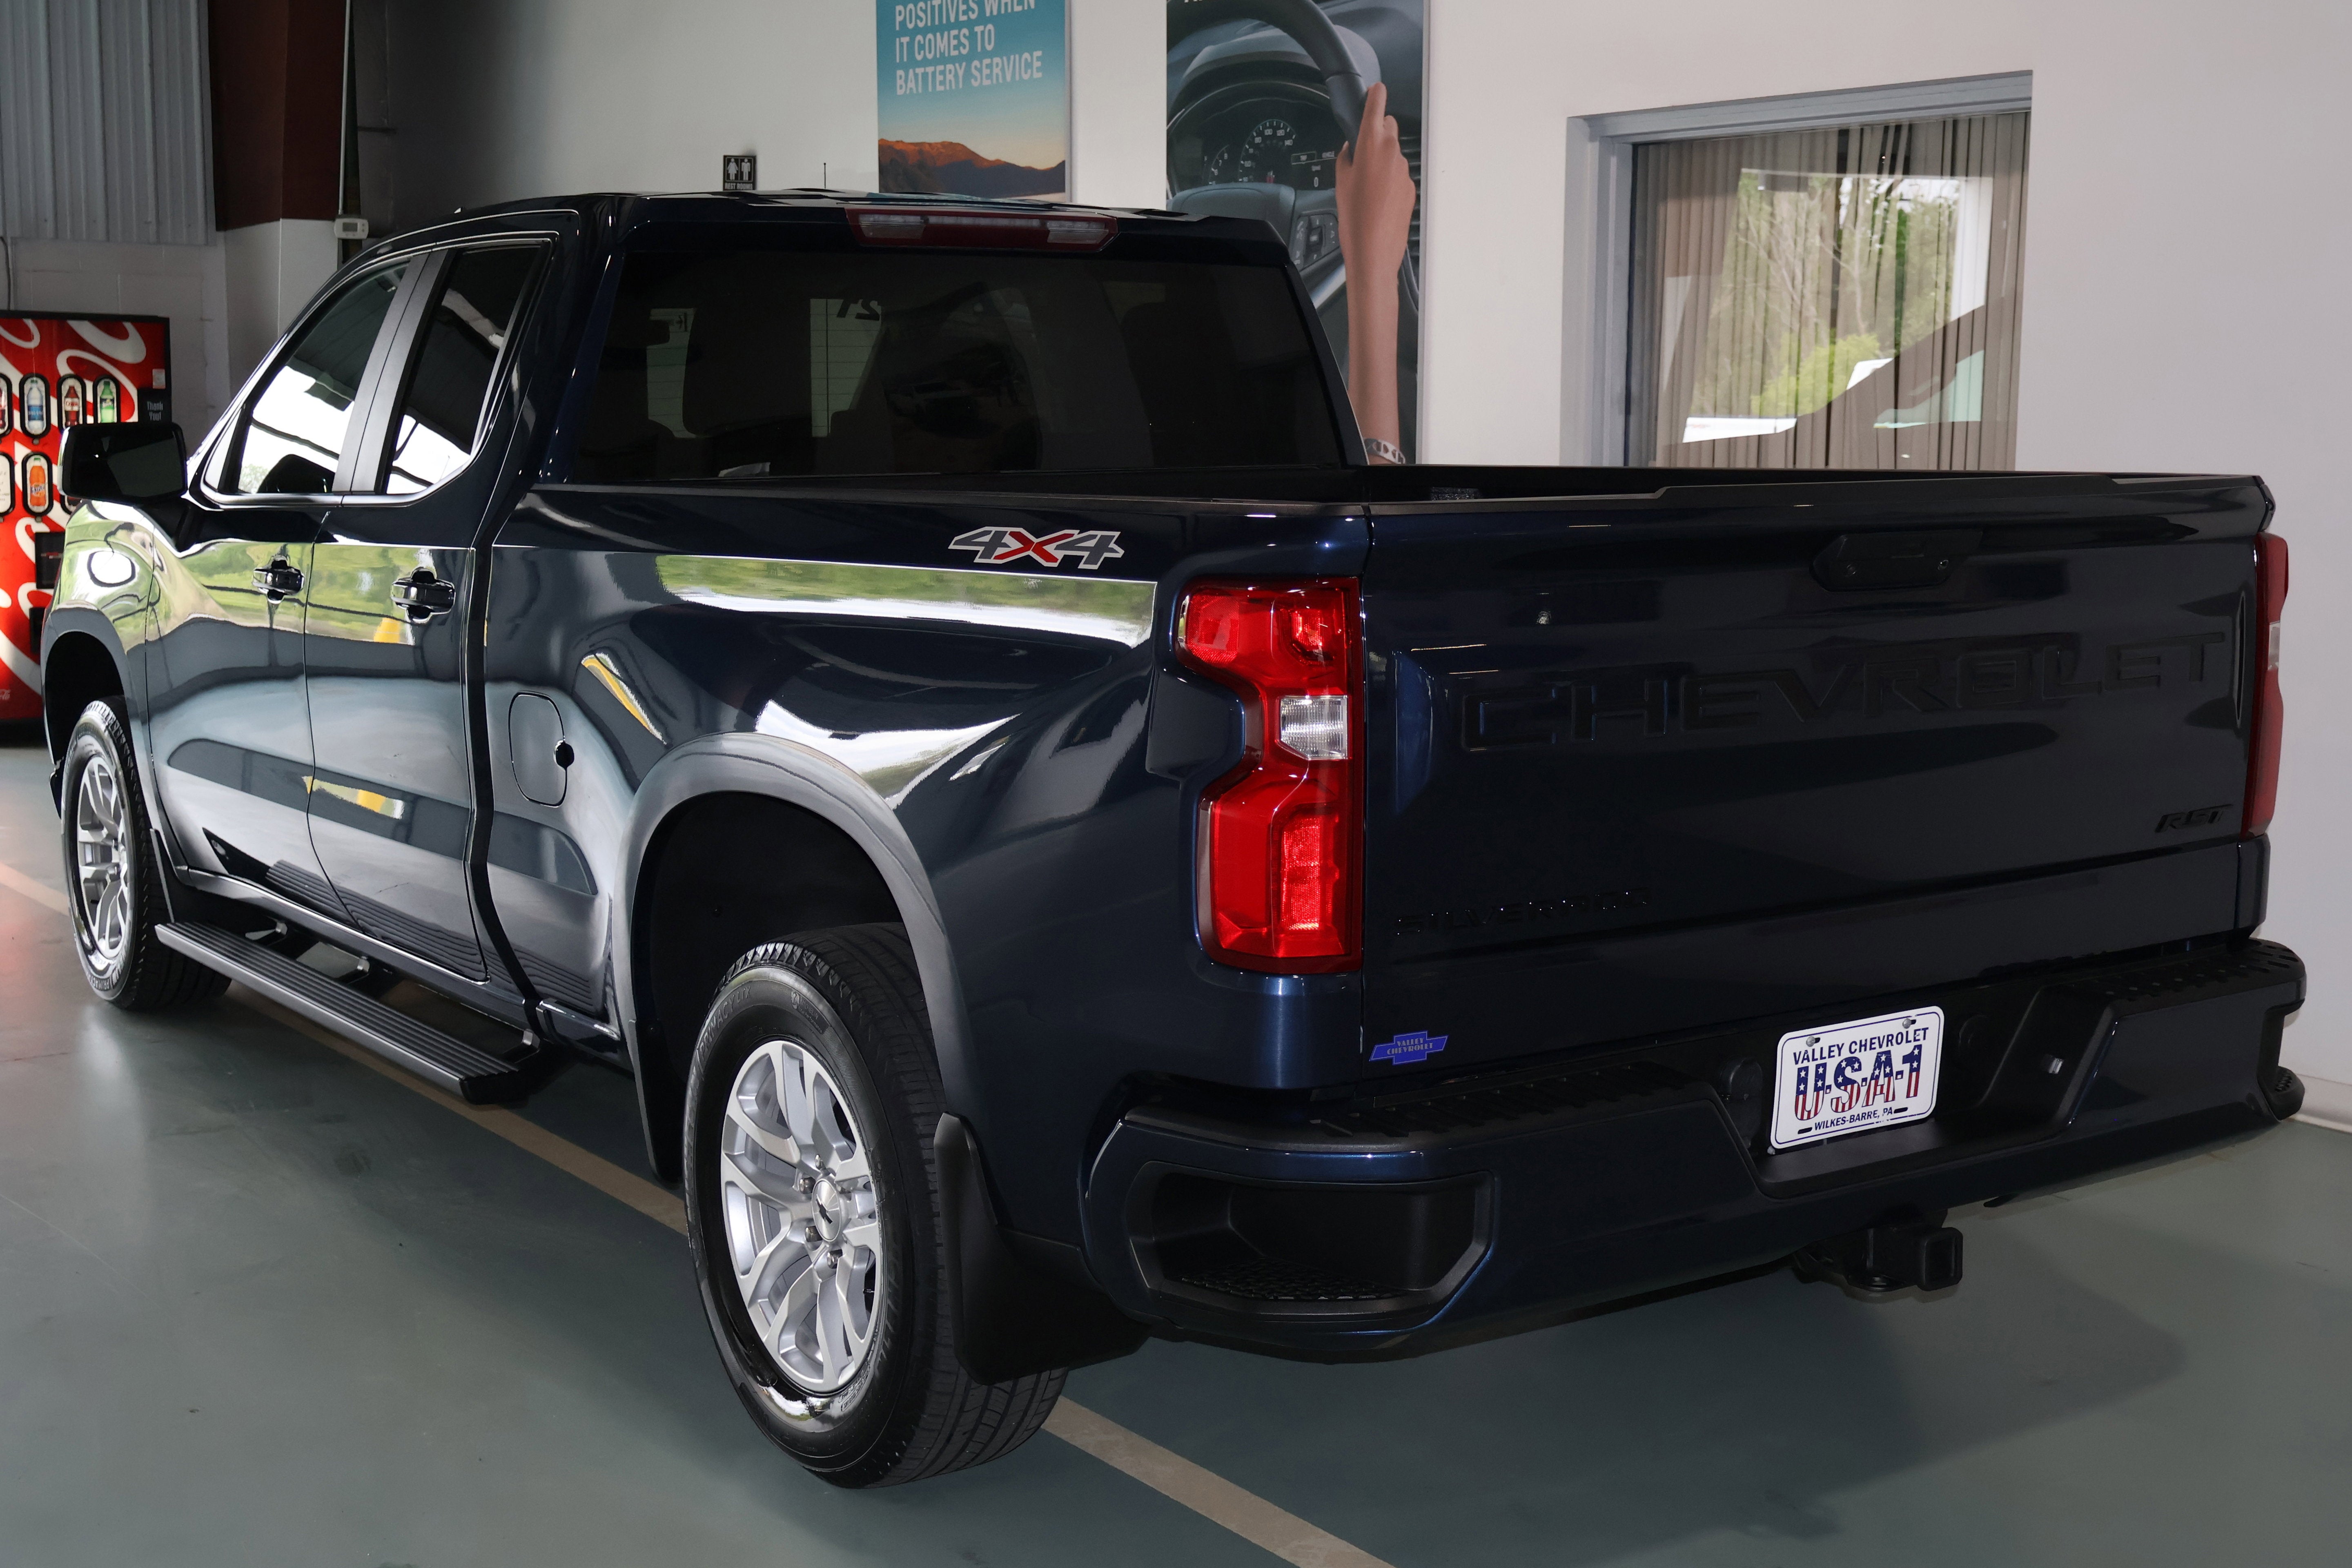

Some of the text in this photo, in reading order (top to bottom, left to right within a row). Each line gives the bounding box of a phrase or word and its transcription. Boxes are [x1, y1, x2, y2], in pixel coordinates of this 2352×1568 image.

[895, 0, 979, 31] POSITIVES
[896, 23, 995, 63] IT COMES TO
[896, 50, 1042, 95] BATTERY SERVICE
[1462, 631, 2225, 751] CHEVROLET
[2154, 804, 2234, 833] RST
[1394, 886, 1653, 935] SILVERADO
[700, 986, 751, 1056] PRIMACY LTX
[1387, 1042, 1433, 1055] CHEVROLET
[1397, 1038, 1424, 1047] VALLEY
[1793, 1027, 1929, 1065] VALLEY CHEVROLET
[1815, 1107, 1893, 1131] WILKES-BARRE, PA
